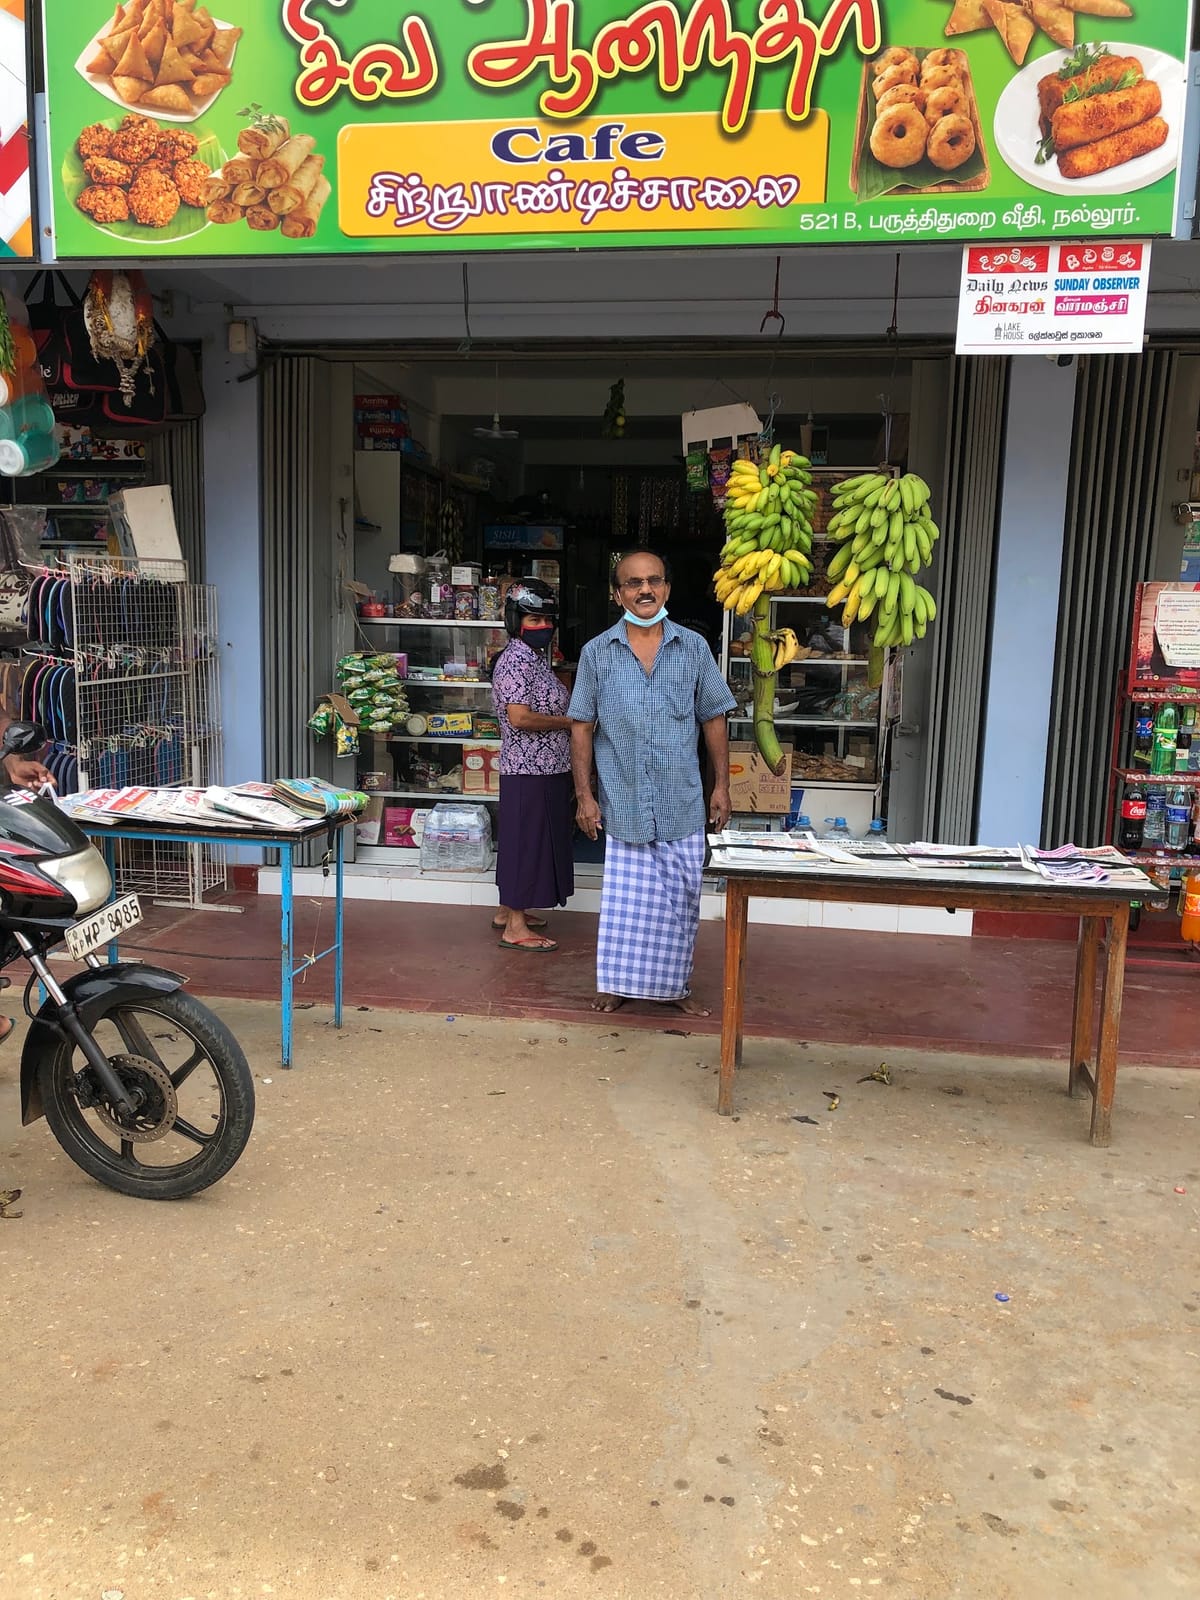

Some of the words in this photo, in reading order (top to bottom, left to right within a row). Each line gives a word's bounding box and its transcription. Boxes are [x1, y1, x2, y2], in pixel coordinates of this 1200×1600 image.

[492, 124, 667, 164] Cafe
[800, 213, 838, 231] 521
[966, 279, 1004, 296] Daily
[1008, 279, 1048, 294] News
[1054, 278, 1090, 291] SUNDAY
[1092, 277, 1140, 290] OBSERVER
[1003, 322, 1021, 331] LAKE
[1003, 331, 1024, 340] HOUSE
[107, 899, 139, 932] 8085
